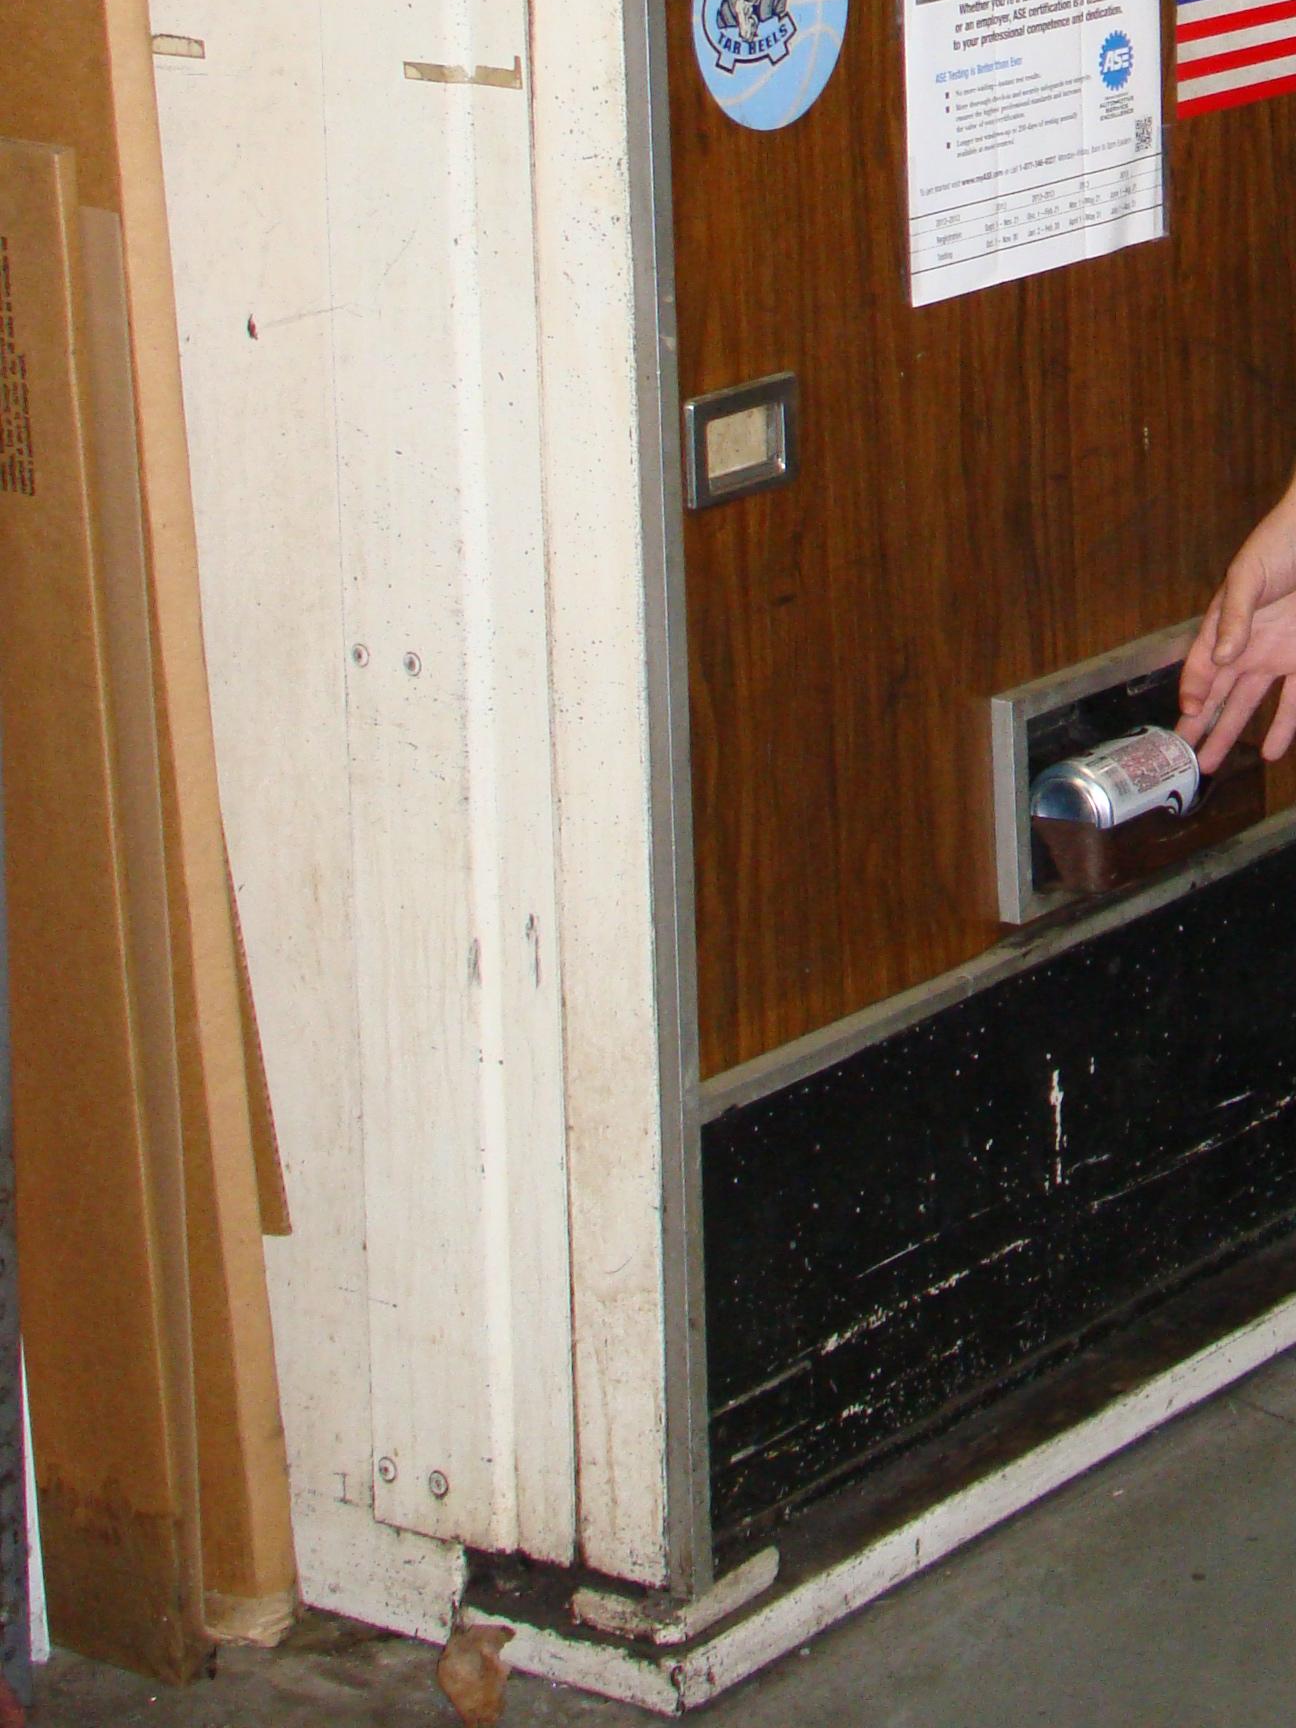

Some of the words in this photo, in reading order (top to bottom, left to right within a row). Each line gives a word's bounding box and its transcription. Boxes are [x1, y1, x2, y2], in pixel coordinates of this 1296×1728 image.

[955, 23, 963, 33] or
[965, 21, 974, 31] an
[1013, 8, 1027, 20] ASE
[1028, 0, 1072, 17] certification
[959, 0, 989, 15] Whether
[718, 32, 741, 55] TAR
[749, 23, 789, 55] HEELS
[953, 40, 961, 51] to
[963, 37, 979, 51] your
[981, 25, 1025, 47] professional
[1027, 17, 1070, 35] competence
[1072, 12, 1084, 24] and
[1103, 46, 1130, 73] ASE
